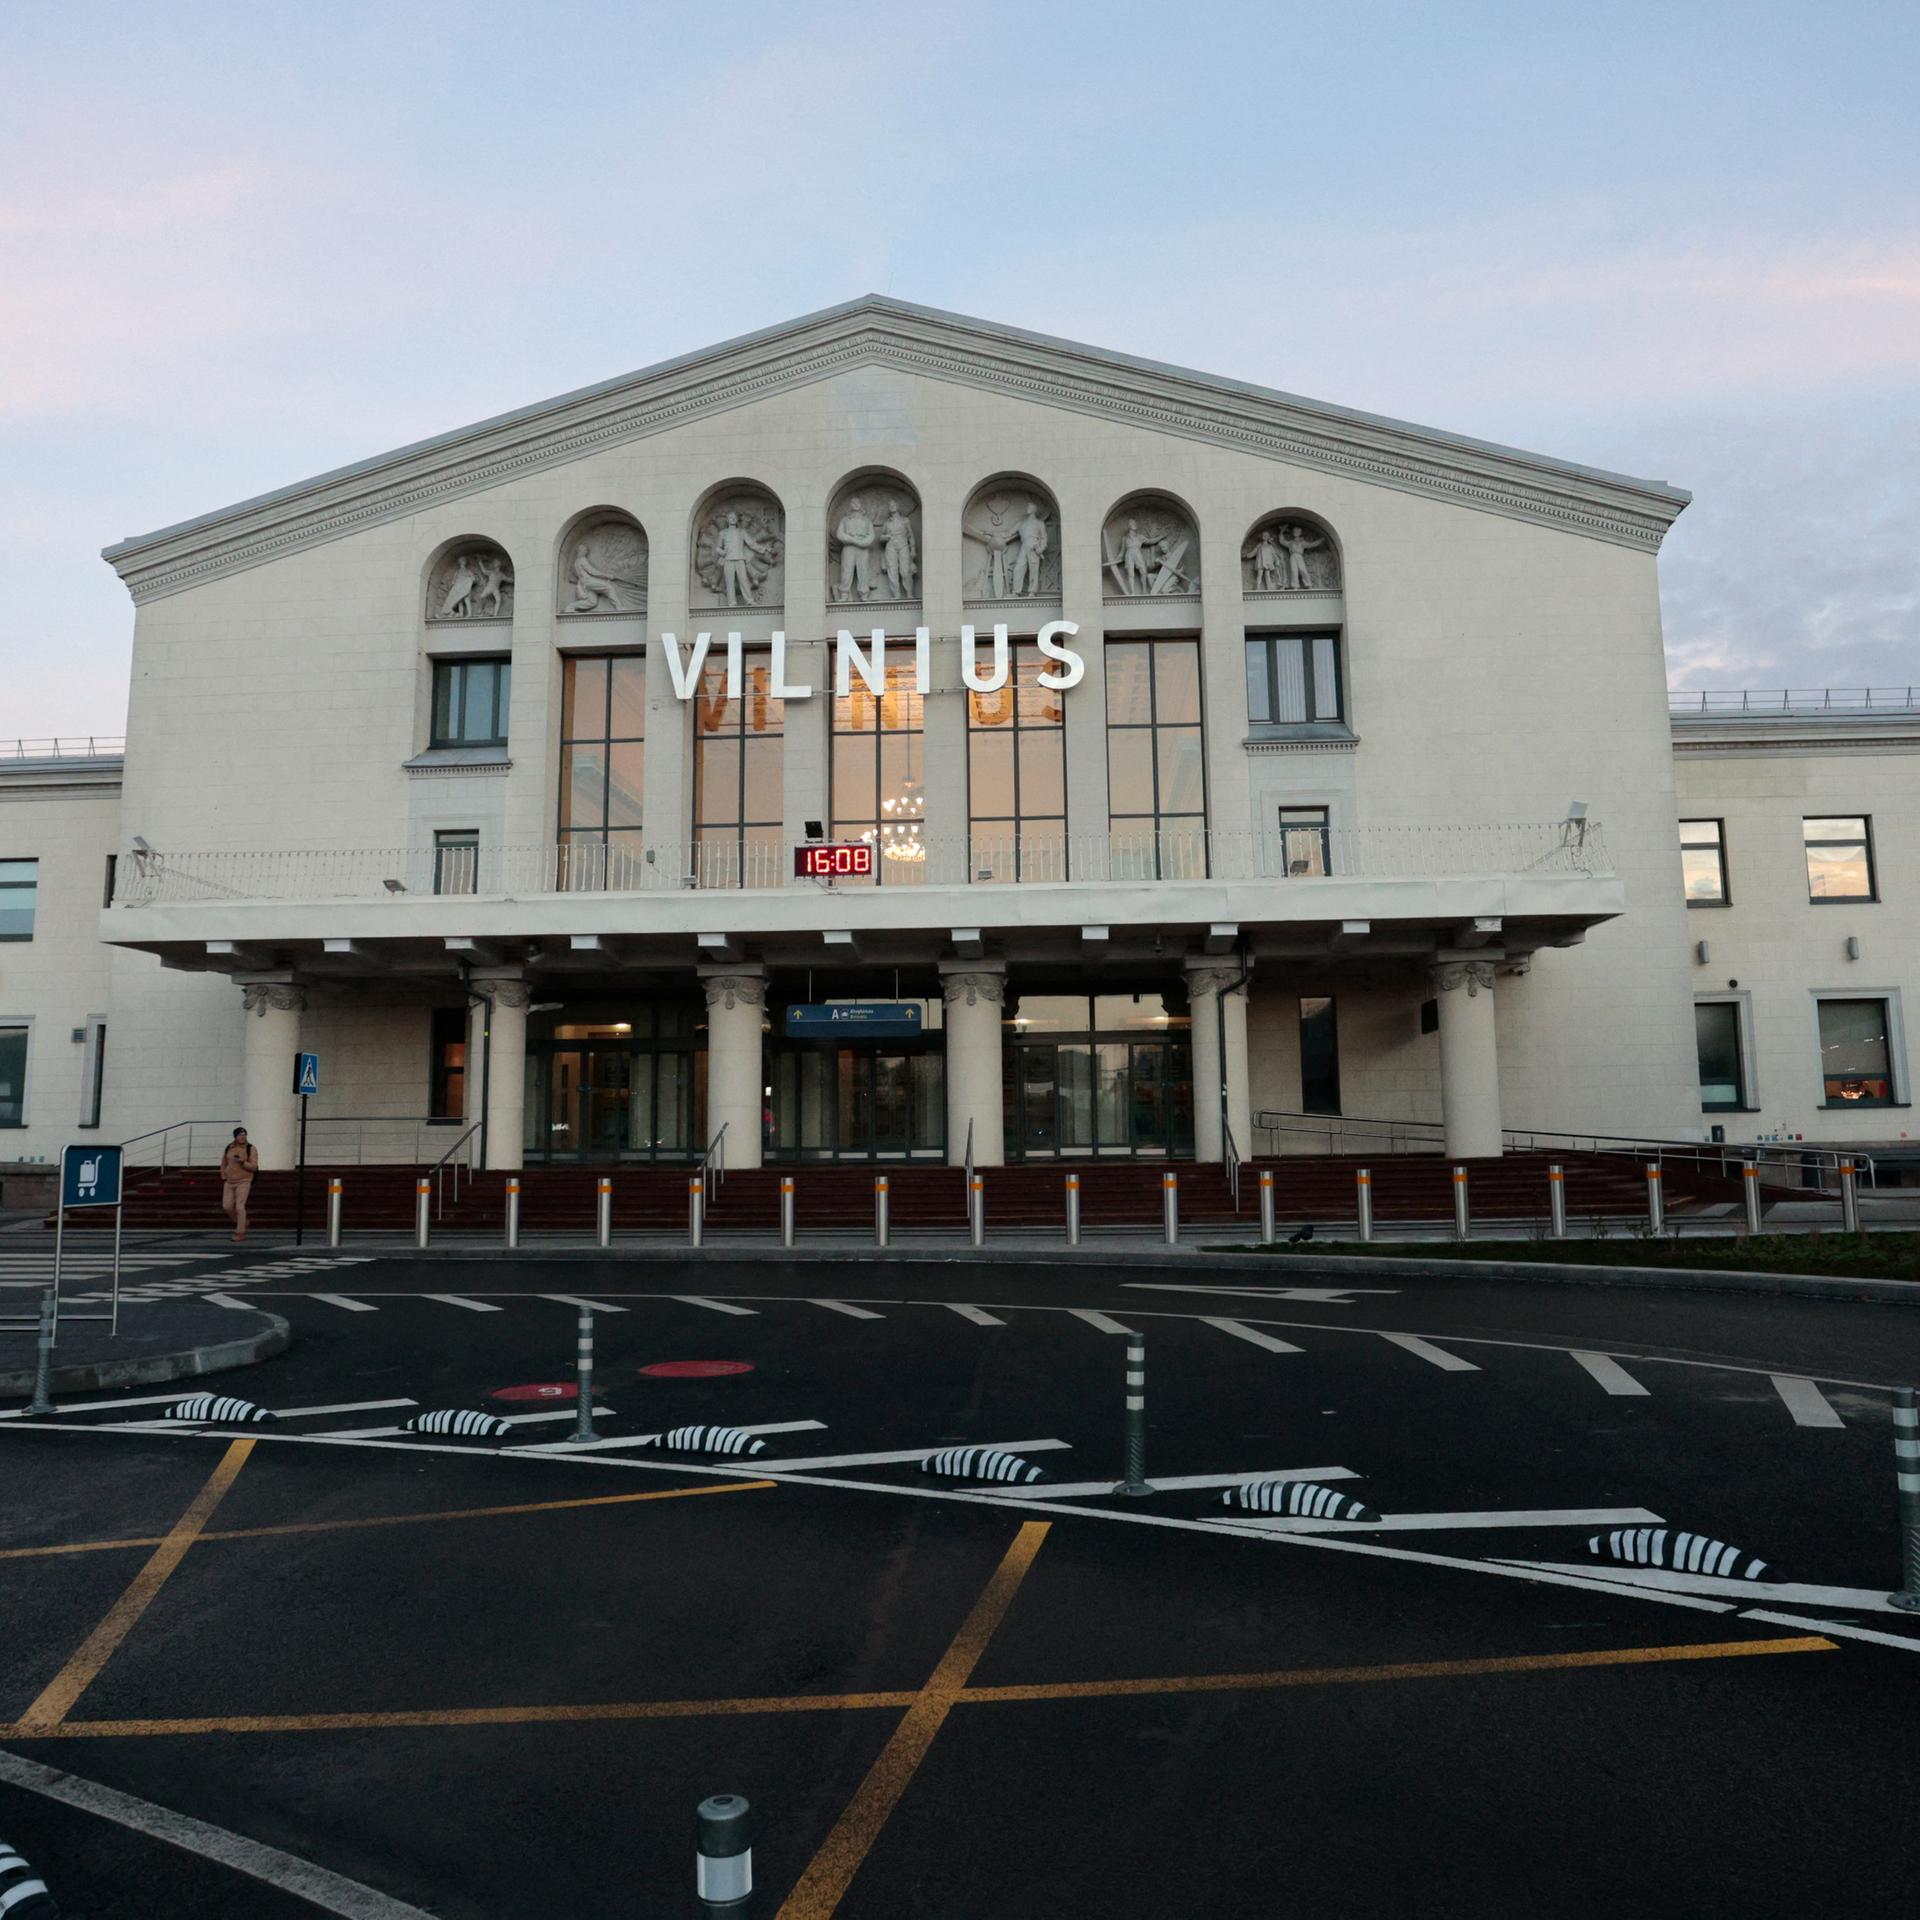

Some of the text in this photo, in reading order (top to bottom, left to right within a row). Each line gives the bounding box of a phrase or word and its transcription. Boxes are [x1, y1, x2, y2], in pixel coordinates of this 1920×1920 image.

[661, 620, 1085, 699] VILNIUS
[807, 849, 869, 872] 16:08
[831, 1008, 839, 1020] A
